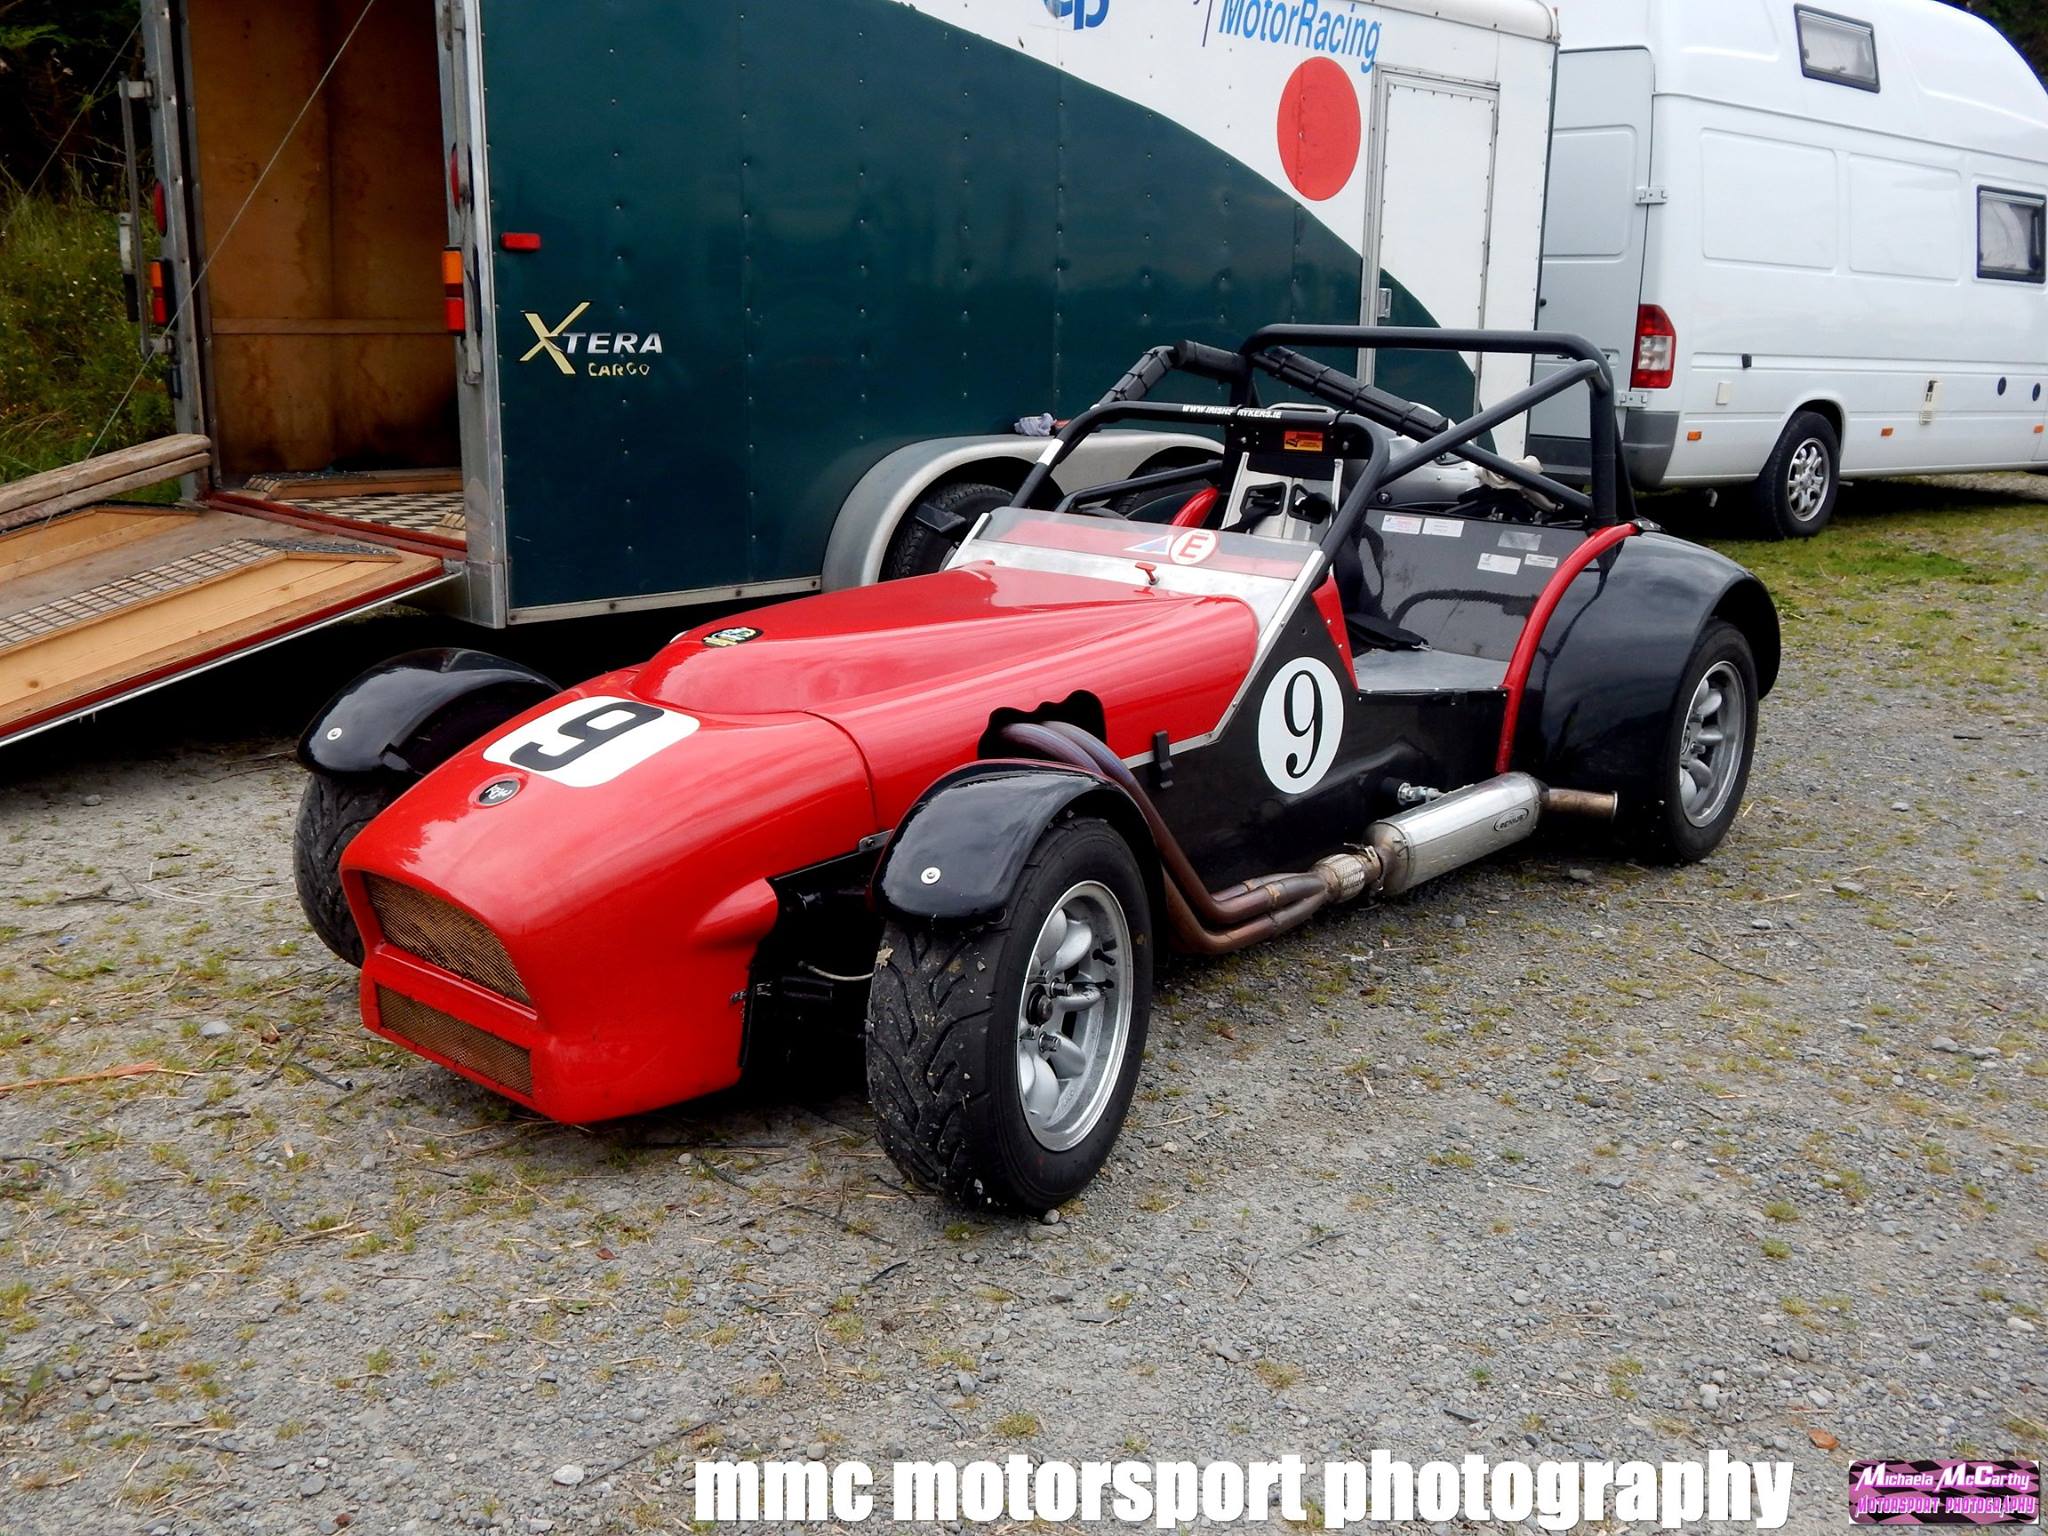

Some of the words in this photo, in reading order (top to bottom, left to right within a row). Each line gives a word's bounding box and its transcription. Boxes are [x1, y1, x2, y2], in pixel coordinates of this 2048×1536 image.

[1219, 0, 1382, 74] MotorRacing
[519, 301, 663, 375] XTERA
[587, 362, 651, 377] CARGO
[509, 701, 665, 771] 9
[1283, 669, 1323, 779] 9
